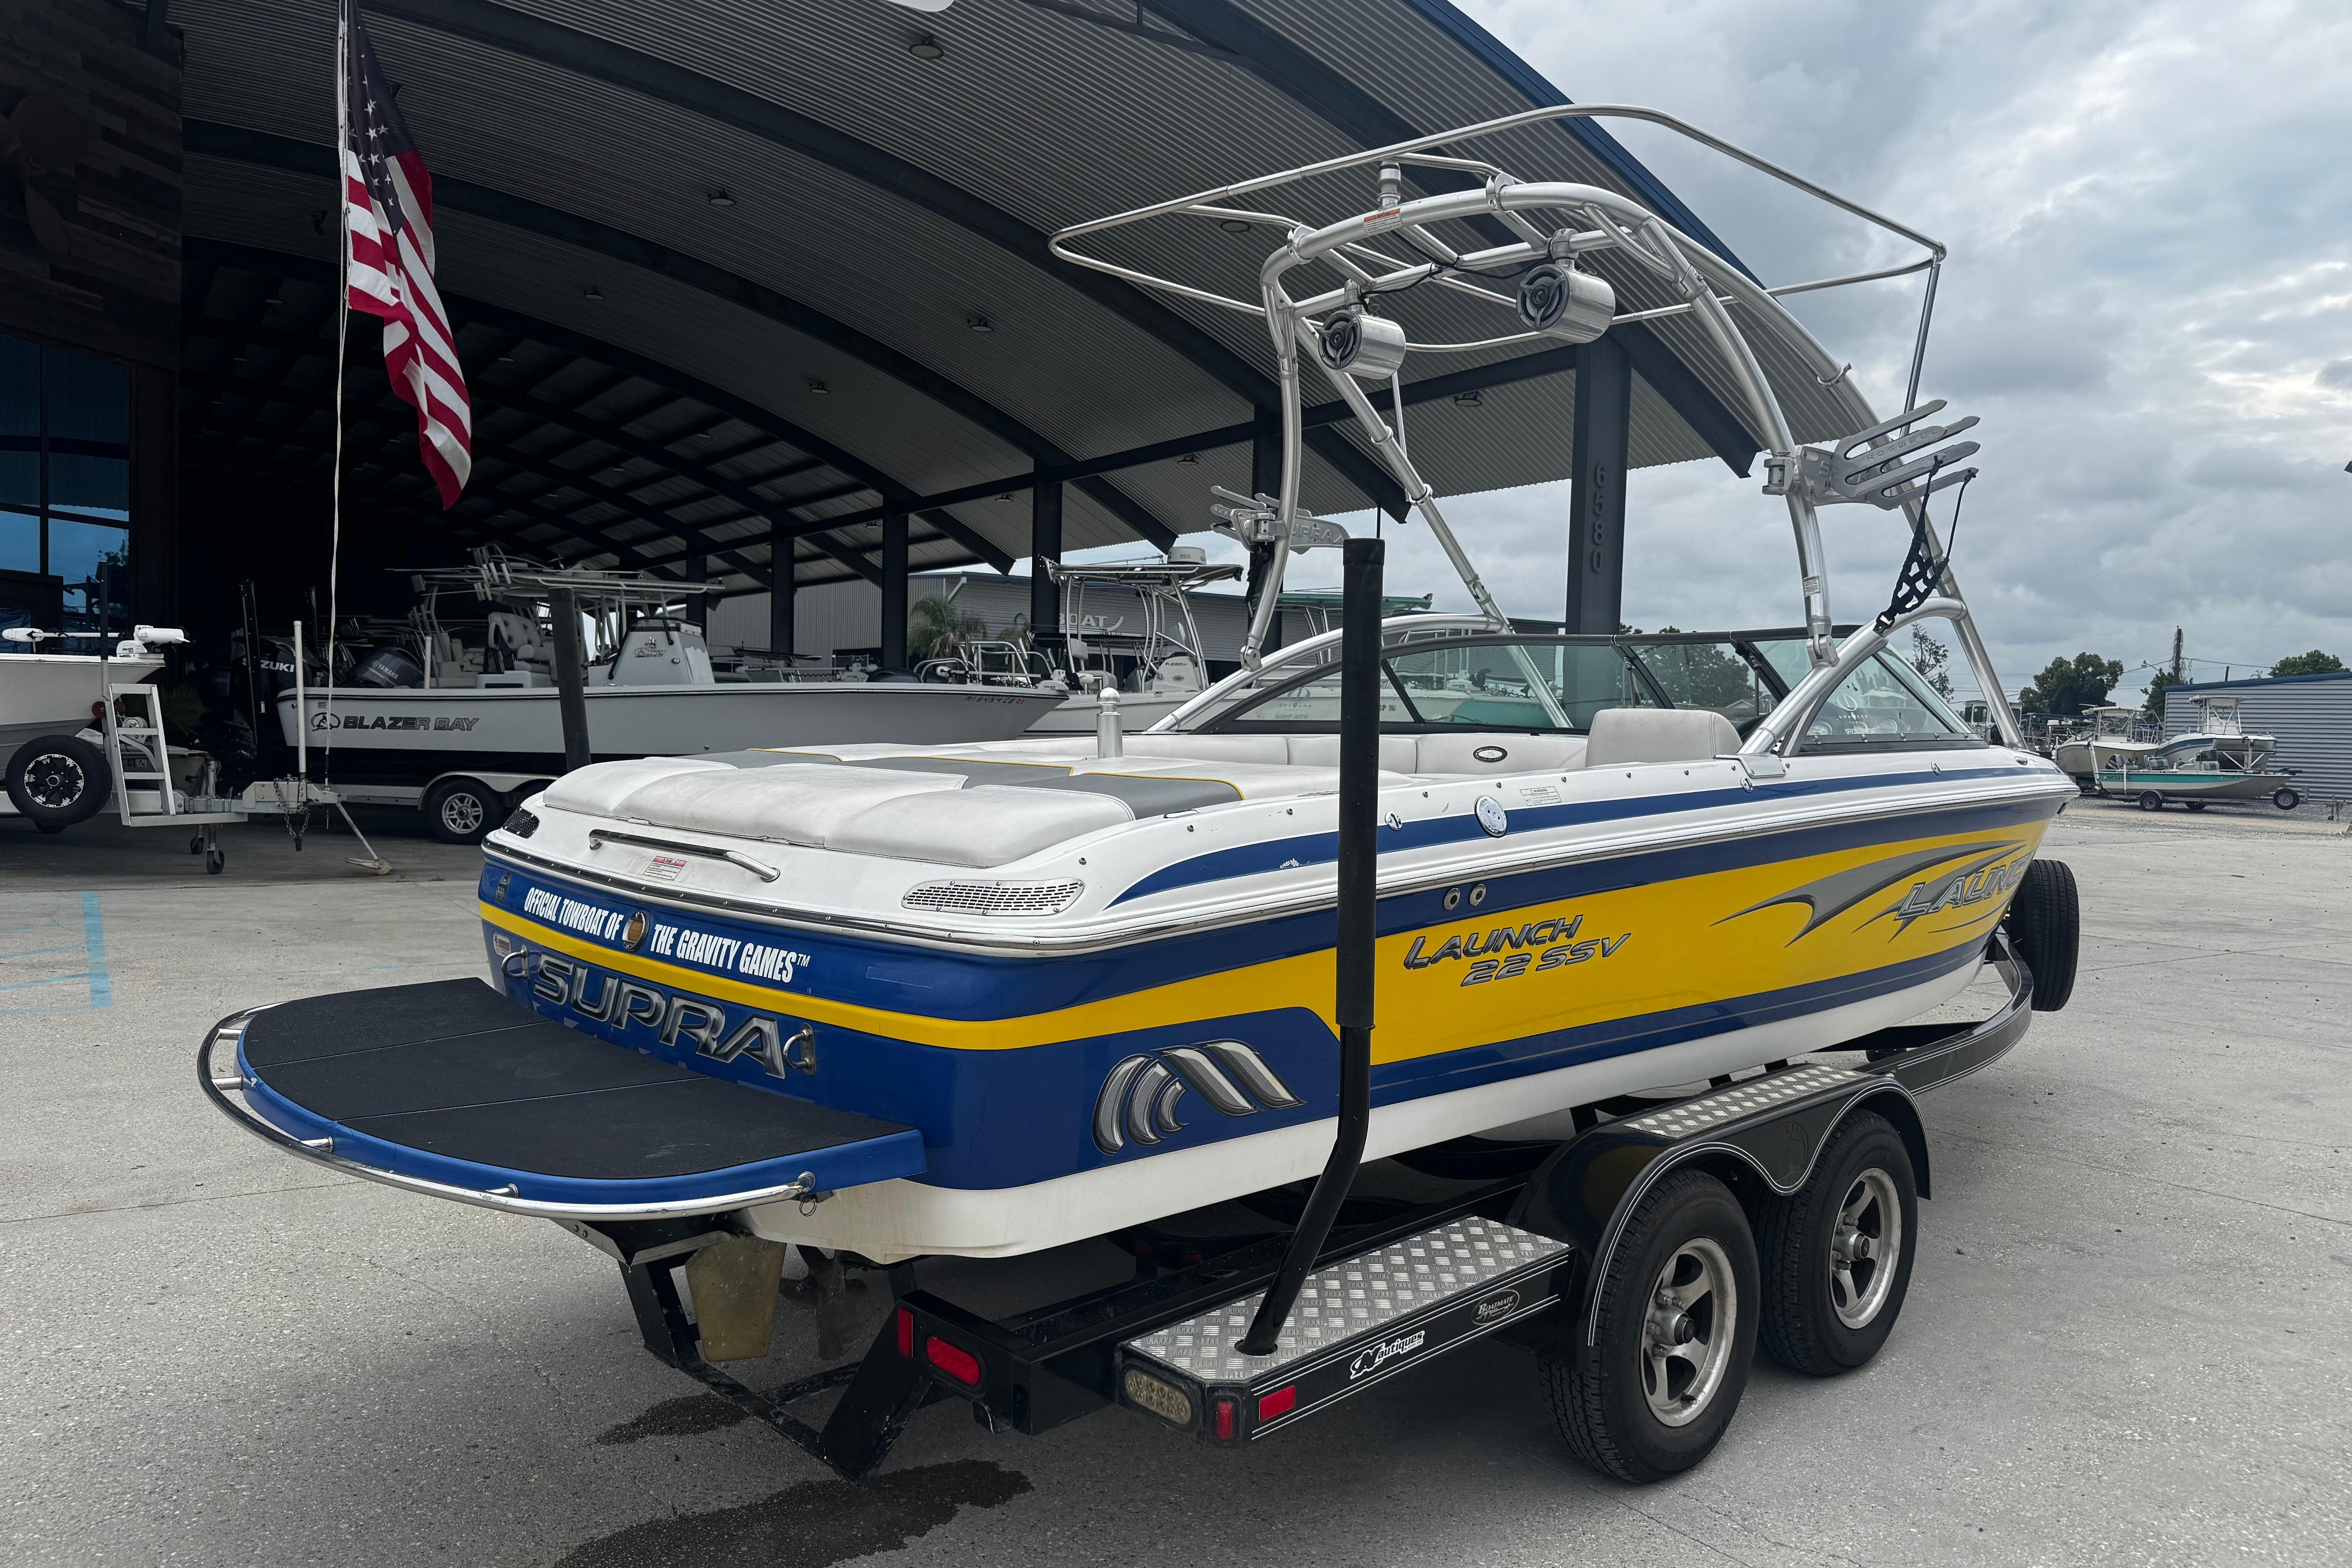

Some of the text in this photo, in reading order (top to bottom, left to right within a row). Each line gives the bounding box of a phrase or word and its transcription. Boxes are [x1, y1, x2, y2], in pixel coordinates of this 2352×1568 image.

[1867, 428, 1938, 462] ROSWELL
[1592, 462, 1608, 574] 6580
[378, 663, 399, 680] YAMAHA
[343, 716, 480, 731] BLAZER BAY
[524, 887, 561, 921] OFFICIAL
[559, 899, 609, 937] TOWBOAT
[604, 912, 623, 941] OF
[651, 924, 678, 956] THE
[676, 930, 741, 970] GRAVITY
[1403, 914, 1583, 970] LAUNCH
[1461, 932, 1632, 987] 22 SSV
[534, 952, 786, 1080] SUPRA
[1478, 1295, 1514, 1315] BOATMATE
[1351, 1331, 1423, 1377] Nautiques
